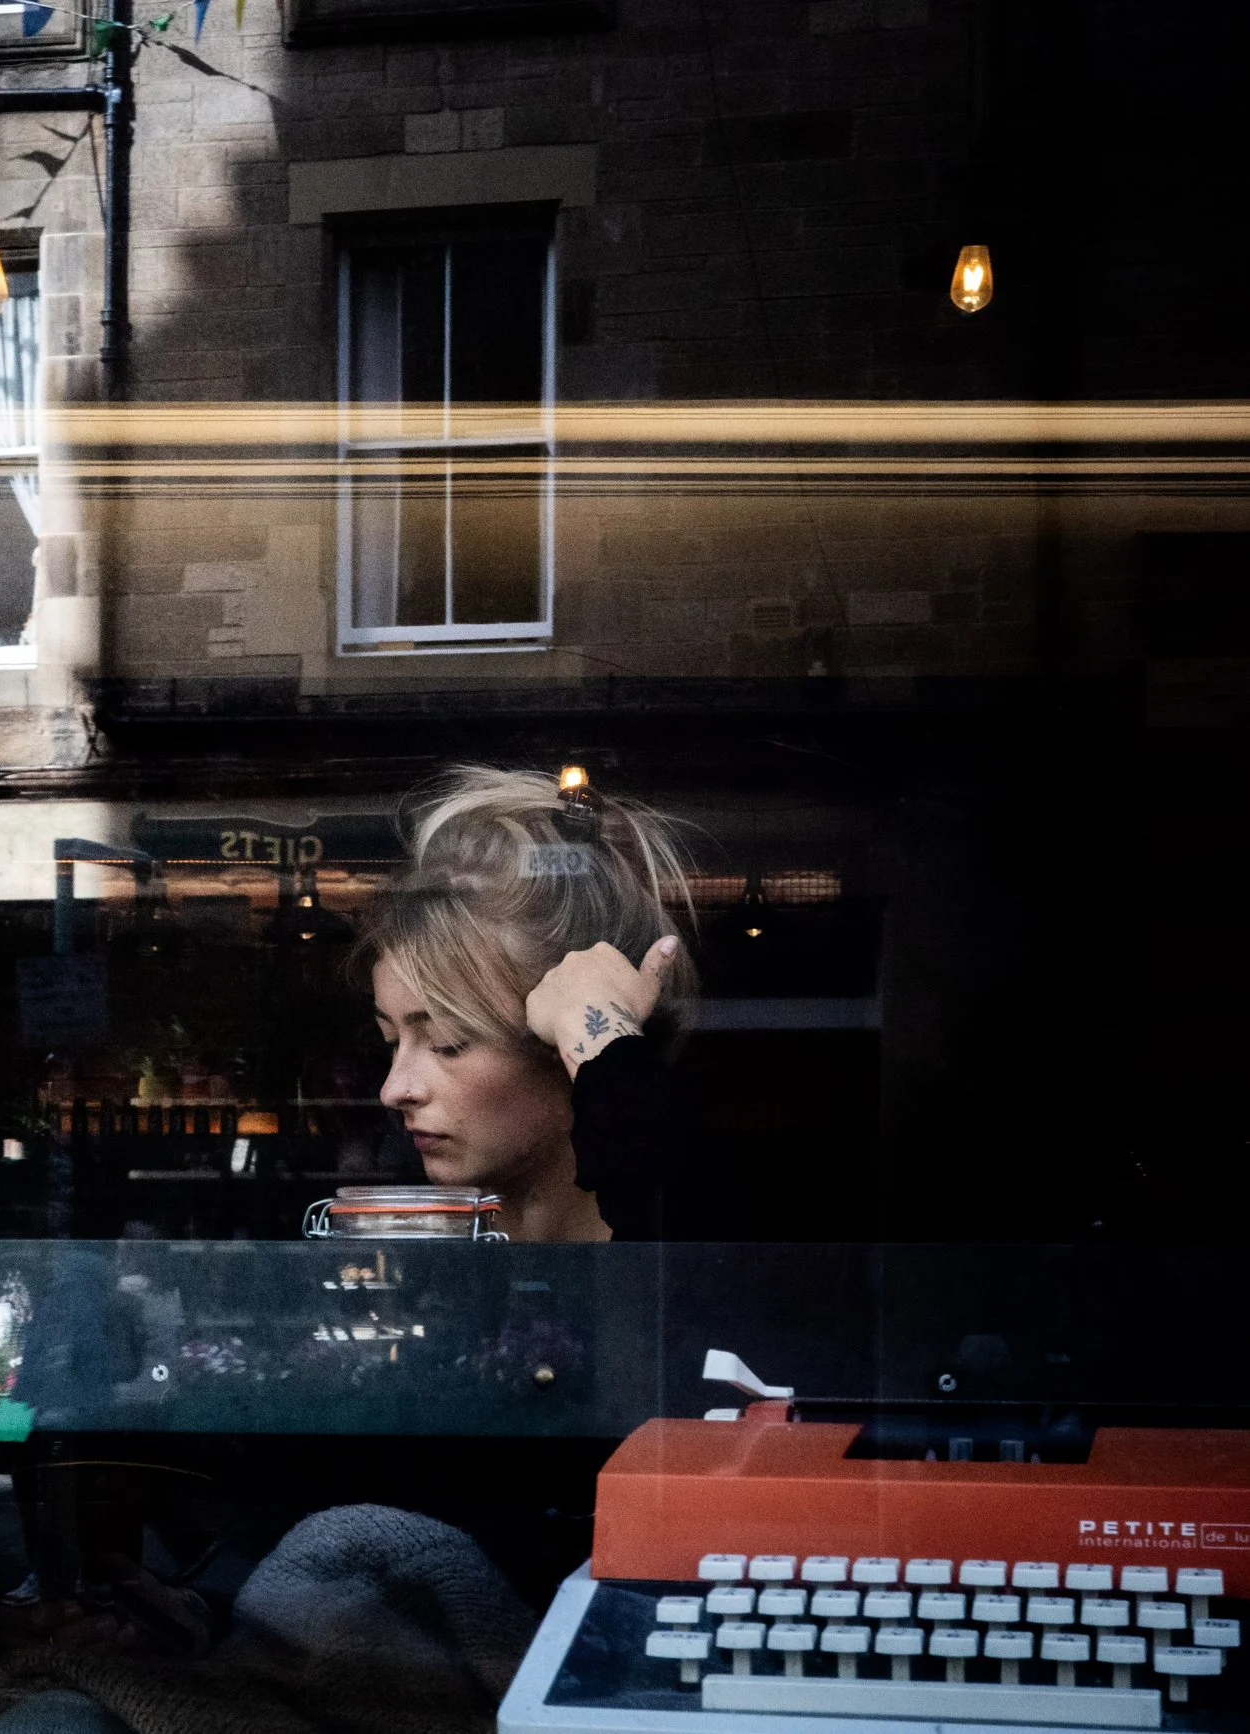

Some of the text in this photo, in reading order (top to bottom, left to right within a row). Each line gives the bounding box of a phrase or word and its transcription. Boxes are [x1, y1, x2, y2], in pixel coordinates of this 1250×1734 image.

[1079, 1519, 1197, 1537] PETITE
[1078, 1535, 1197, 1549] international
[1205, 1531, 1227, 1543] de
